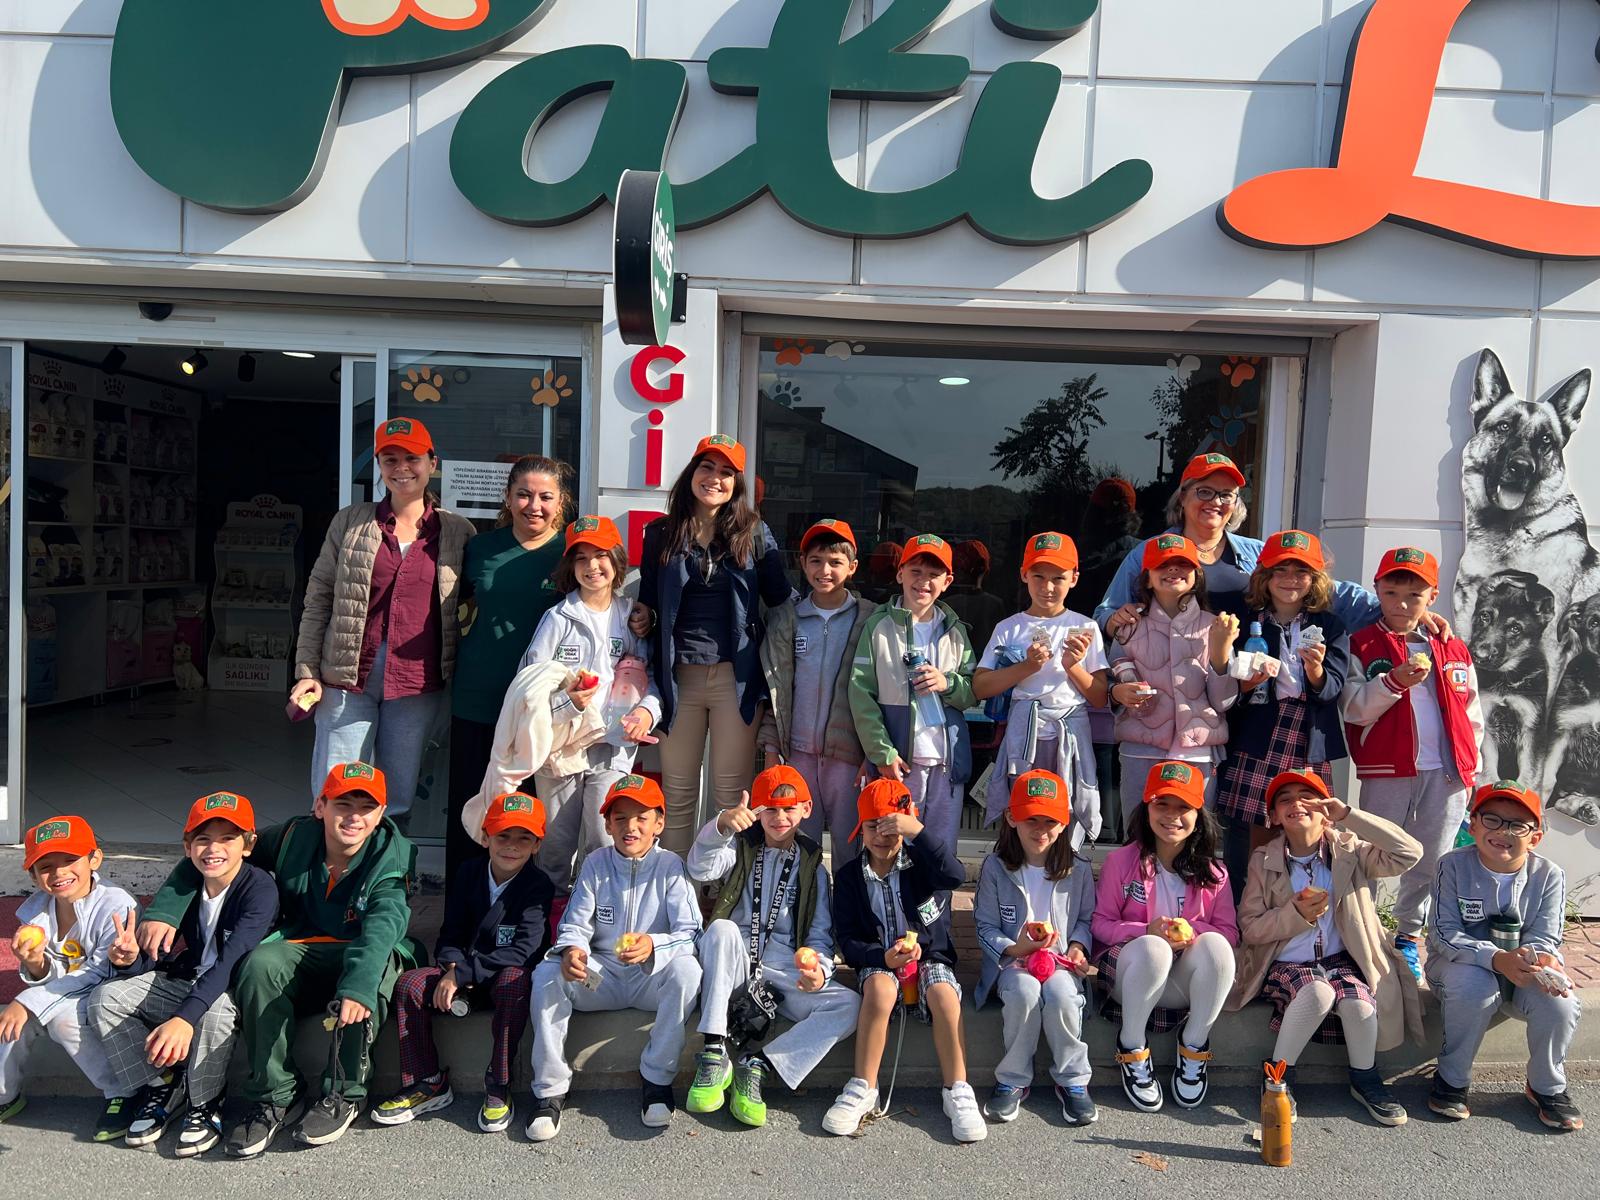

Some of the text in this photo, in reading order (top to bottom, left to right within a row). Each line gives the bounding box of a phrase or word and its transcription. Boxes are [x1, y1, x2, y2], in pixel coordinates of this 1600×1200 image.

[768, 880, 786, 930] FLASH BEAR
[750, 912, 760, 964] FLASH BEAR
